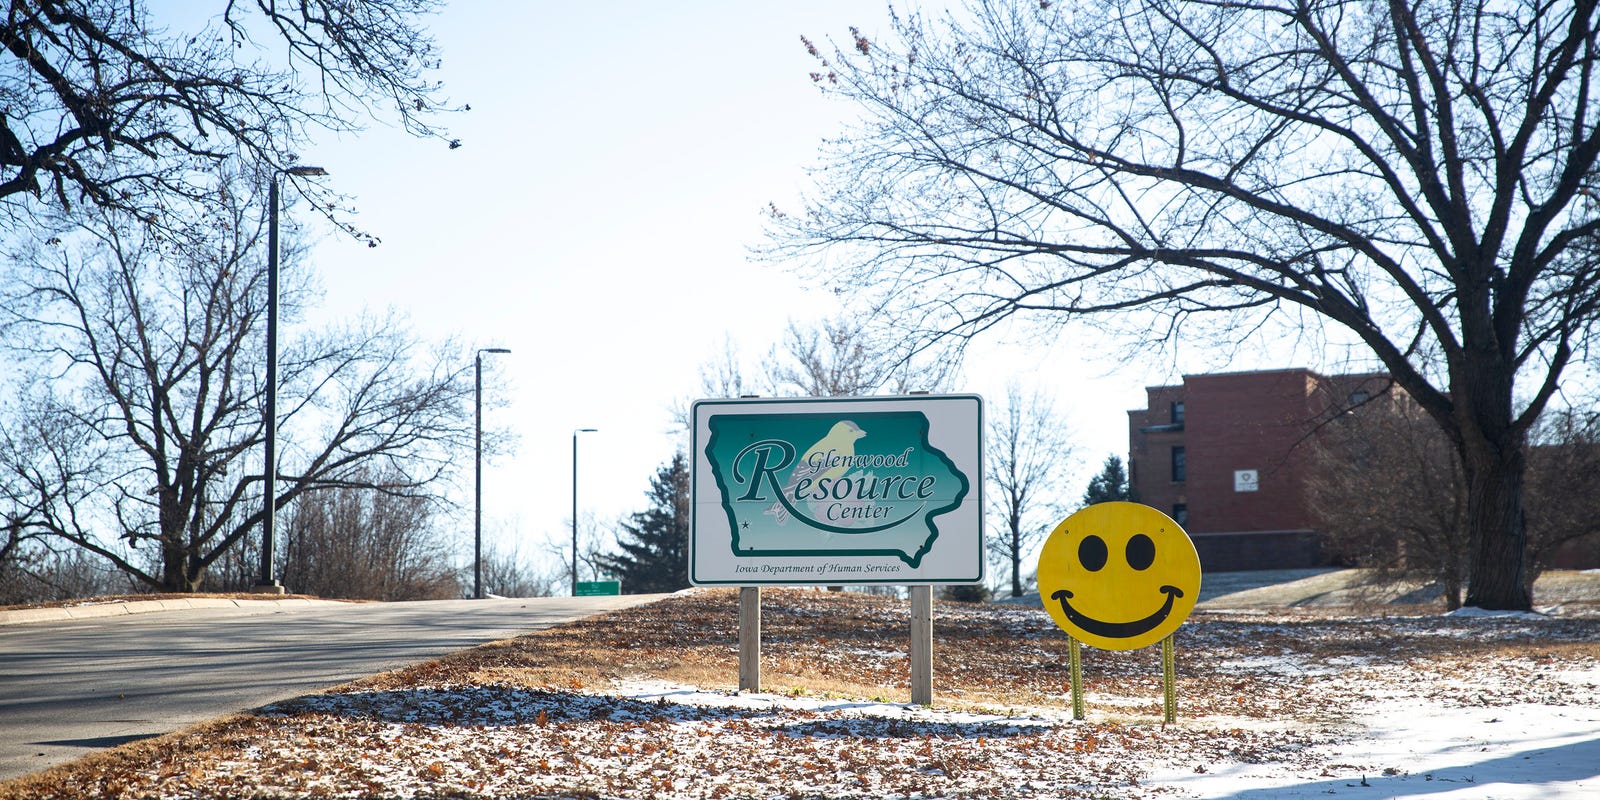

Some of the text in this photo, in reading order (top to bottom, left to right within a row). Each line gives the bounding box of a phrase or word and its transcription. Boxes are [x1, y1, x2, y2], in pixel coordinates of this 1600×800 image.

[808, 447, 913, 475] Glenwood
[732, 439, 936, 533] Resource
[826, 502, 894, 521] Center
[735, 563, 900, 575] Iowa Department of Human Services
